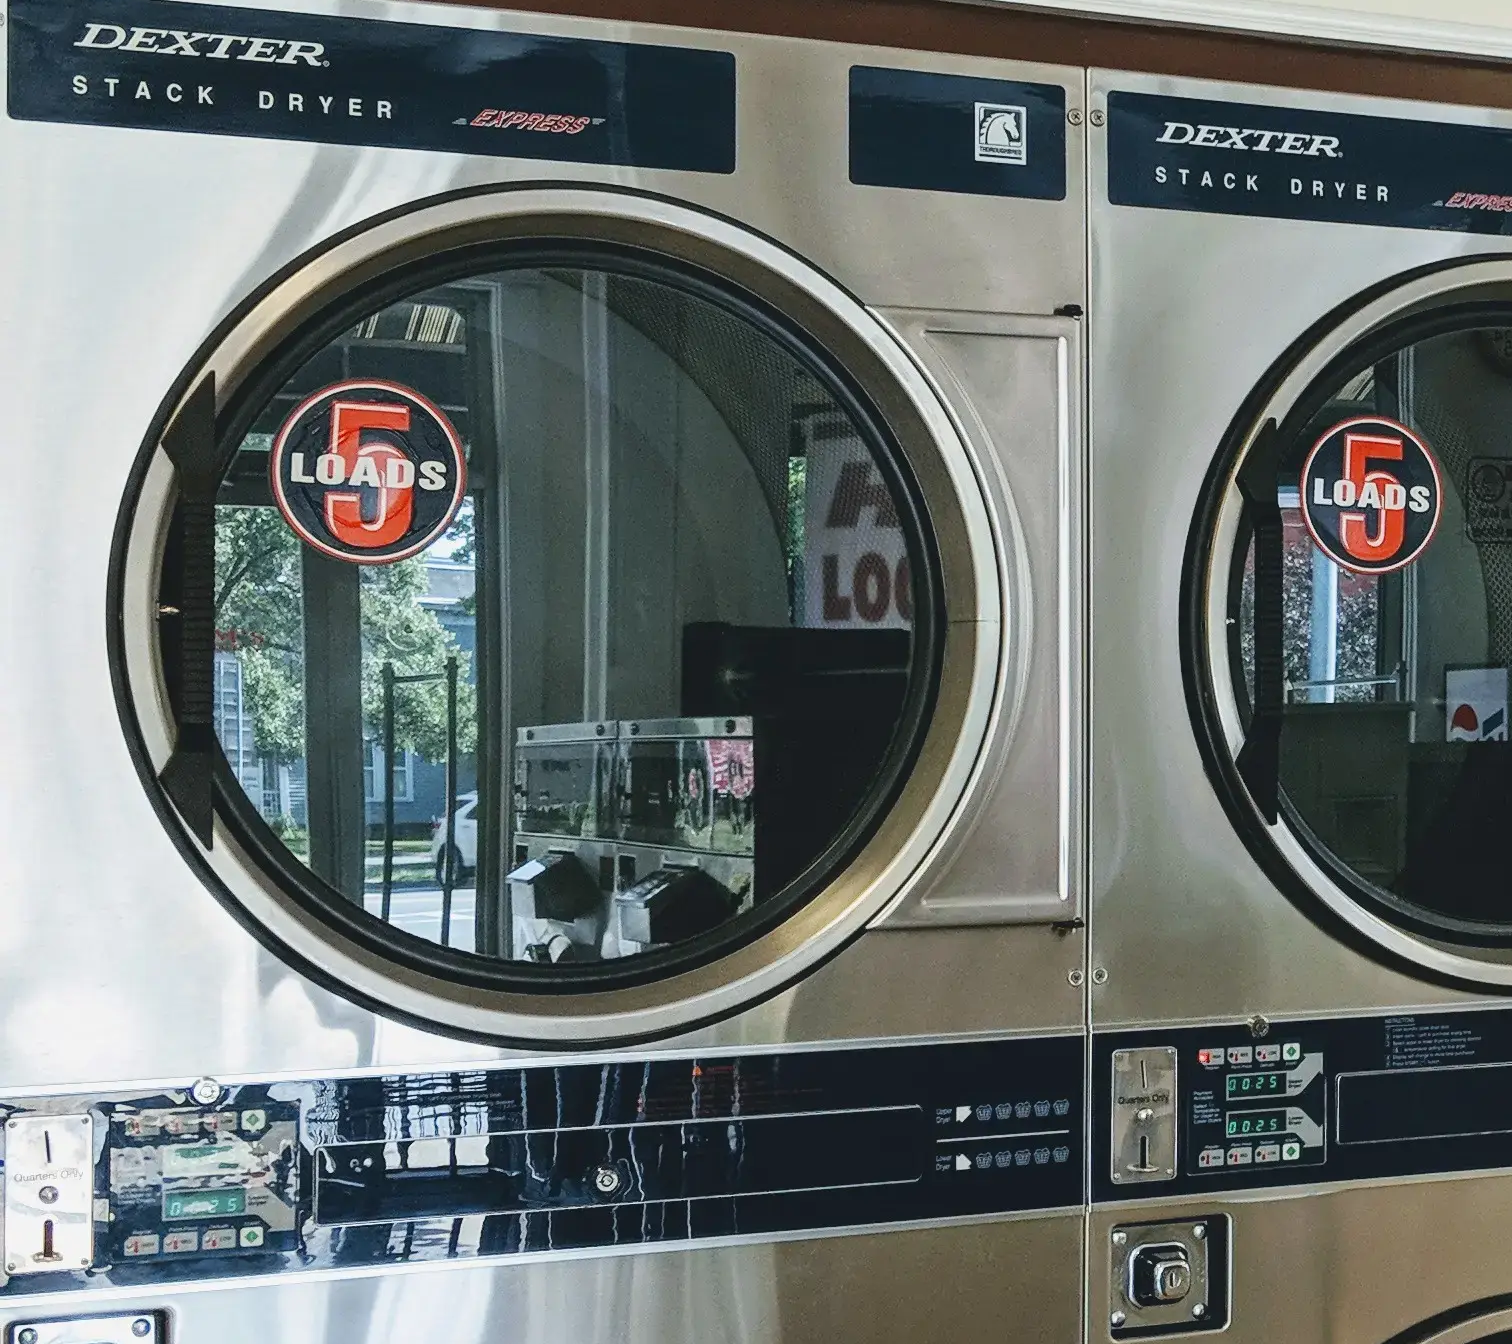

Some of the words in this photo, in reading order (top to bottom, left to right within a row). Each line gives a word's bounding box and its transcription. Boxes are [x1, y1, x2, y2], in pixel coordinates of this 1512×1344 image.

[73, 23, 327, 67] DEXTER
[73, 74, 214, 105] STACK
[259, 90, 393, 119] DRYER
[470, 108, 591, 135] EXPRESS
[1155, 122, 1342, 159] DEXTER
[1155, 165, 1260, 190] STACK
[1290, 178, 1390, 202] DRYER
[290, 452, 448, 491] LOADS
[324, 400, 414, 548] 5
[1313, 477, 1431, 513] LOADS
[1340, 432, 1405, 562] 5
[14, 1171, 57, 1182] Quarters
